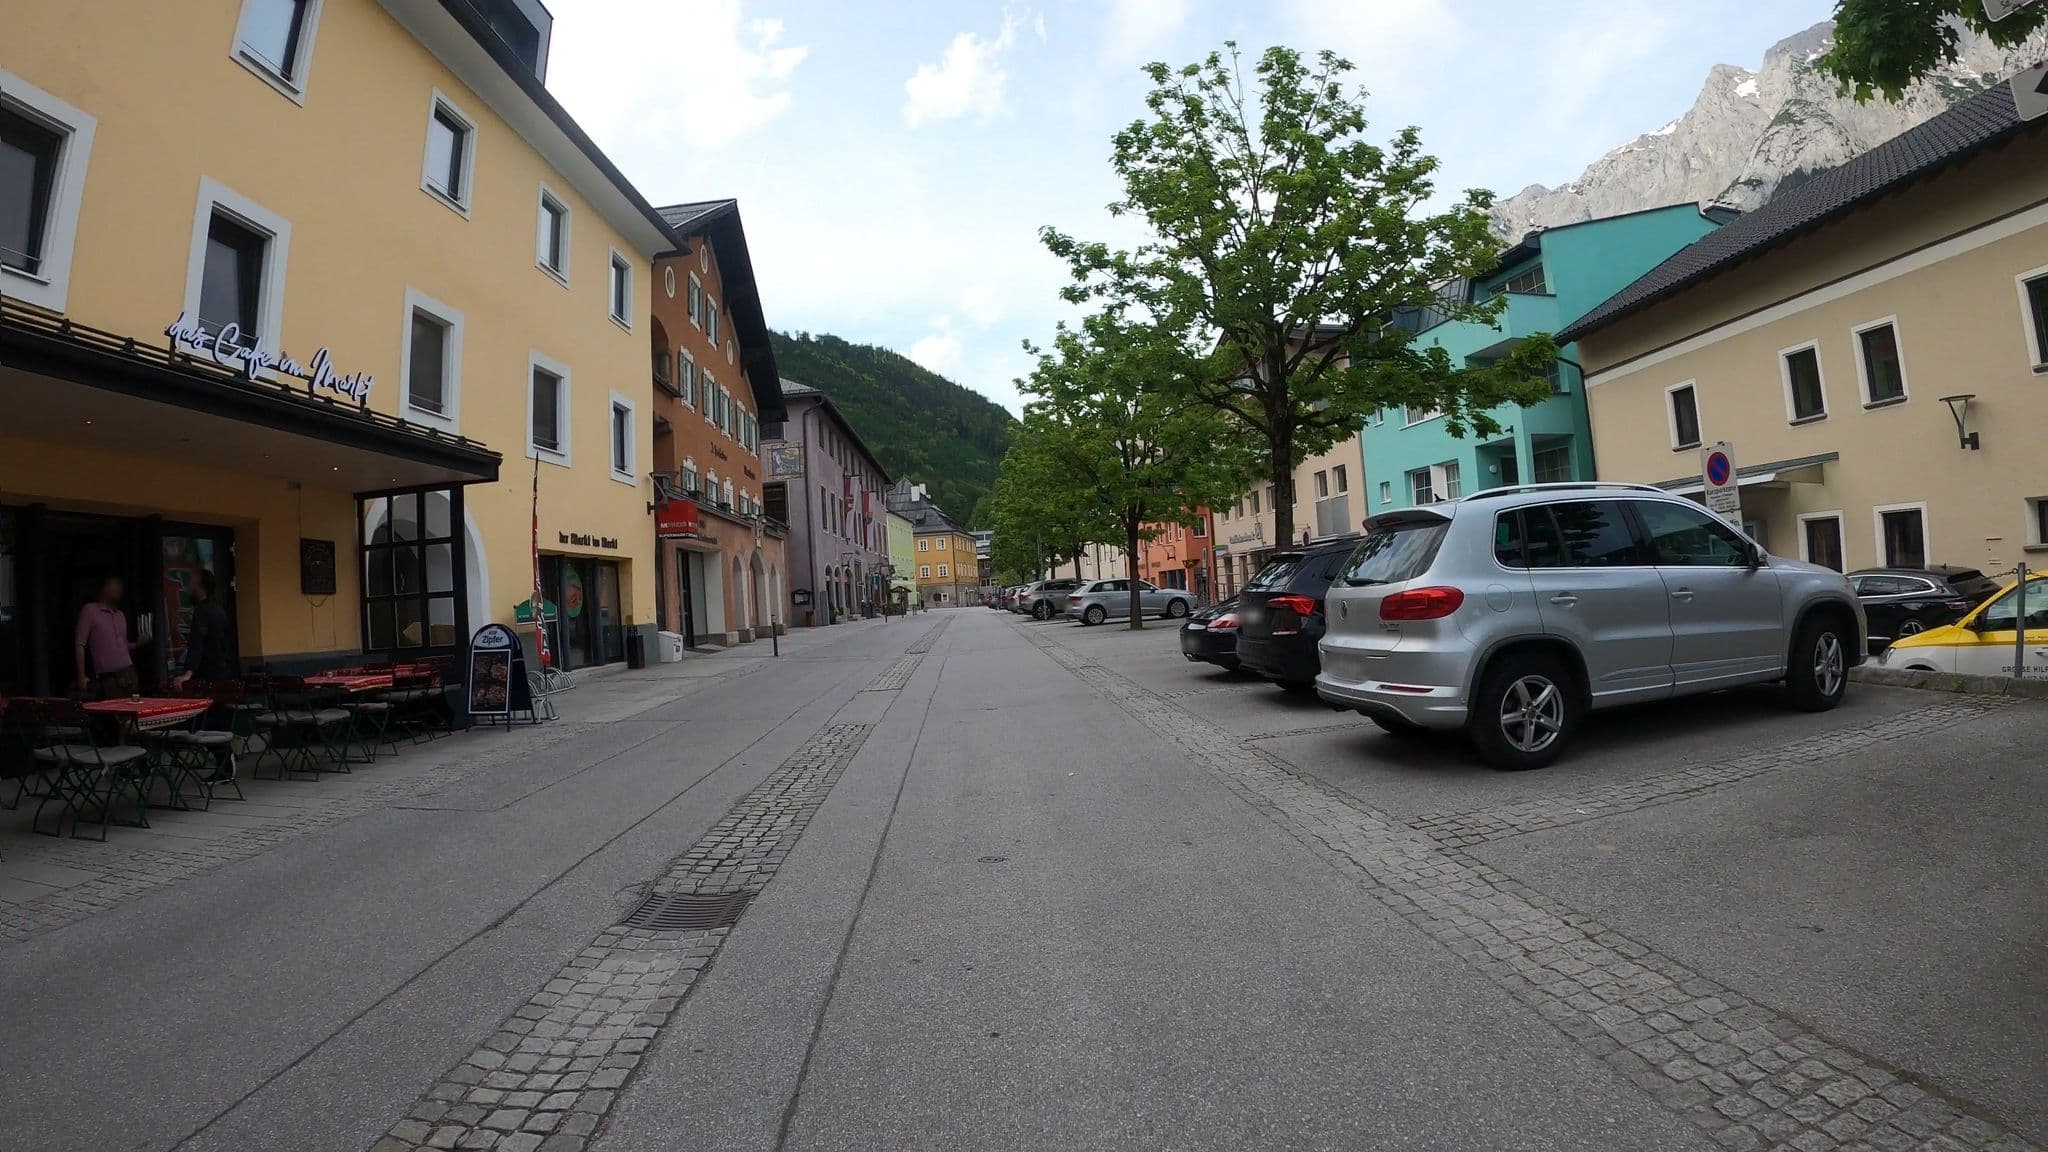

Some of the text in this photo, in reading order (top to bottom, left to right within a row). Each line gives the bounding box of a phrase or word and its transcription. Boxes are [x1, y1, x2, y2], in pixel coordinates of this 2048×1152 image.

[166, 312, 214, 349] das
[279, 351, 304, 376] im
[310, 346, 374, 402] Markt
[482, 635, 503, 645] Zipfer
